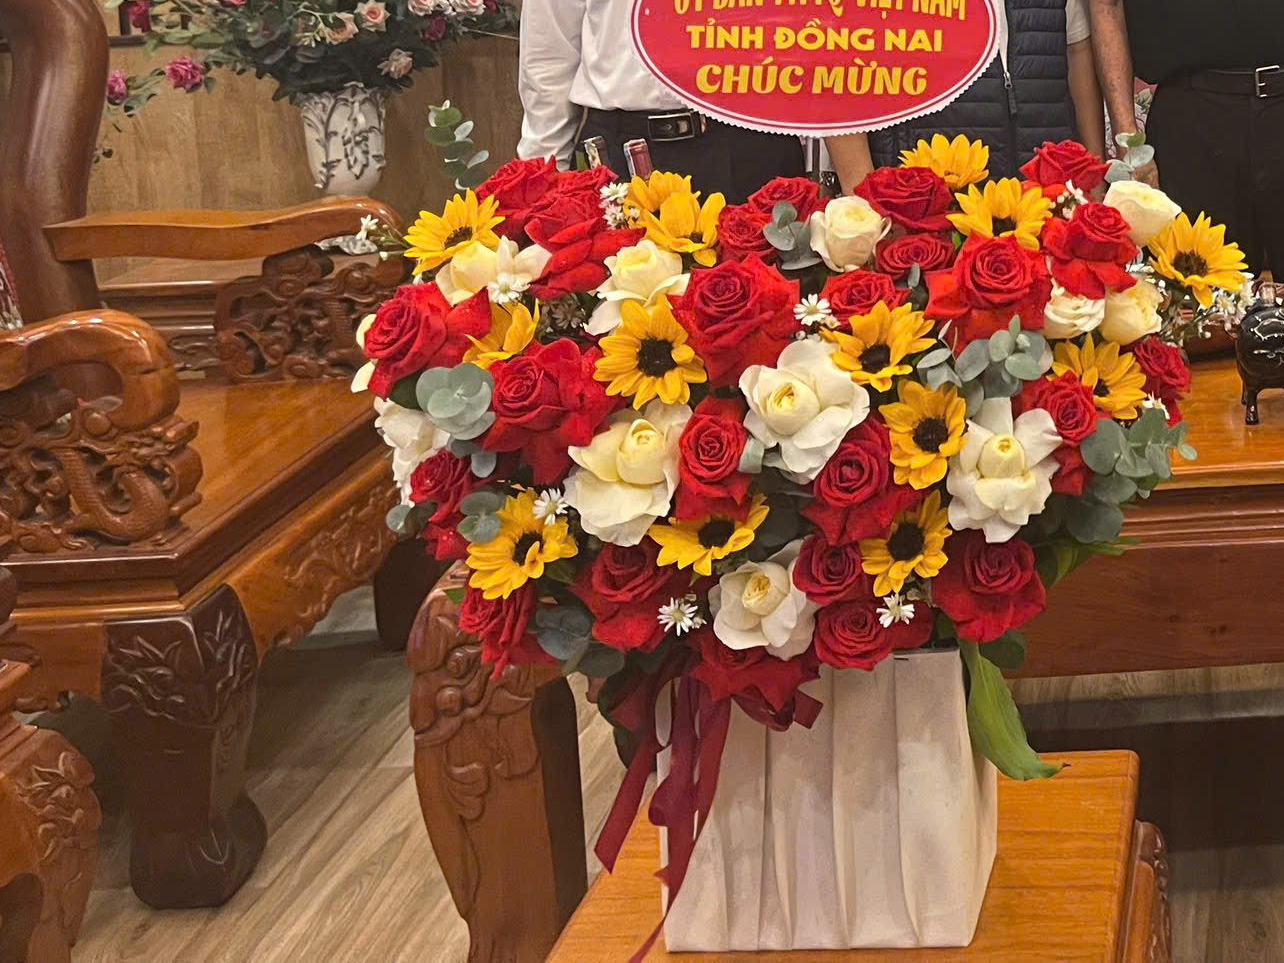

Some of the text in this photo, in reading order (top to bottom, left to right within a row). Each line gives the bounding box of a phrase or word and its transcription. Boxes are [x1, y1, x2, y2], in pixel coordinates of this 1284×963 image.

[686, 18, 942, 51] TỈNH ĐỒNG NAI
[696, 57, 927, 95] CHÚC MỪNG
